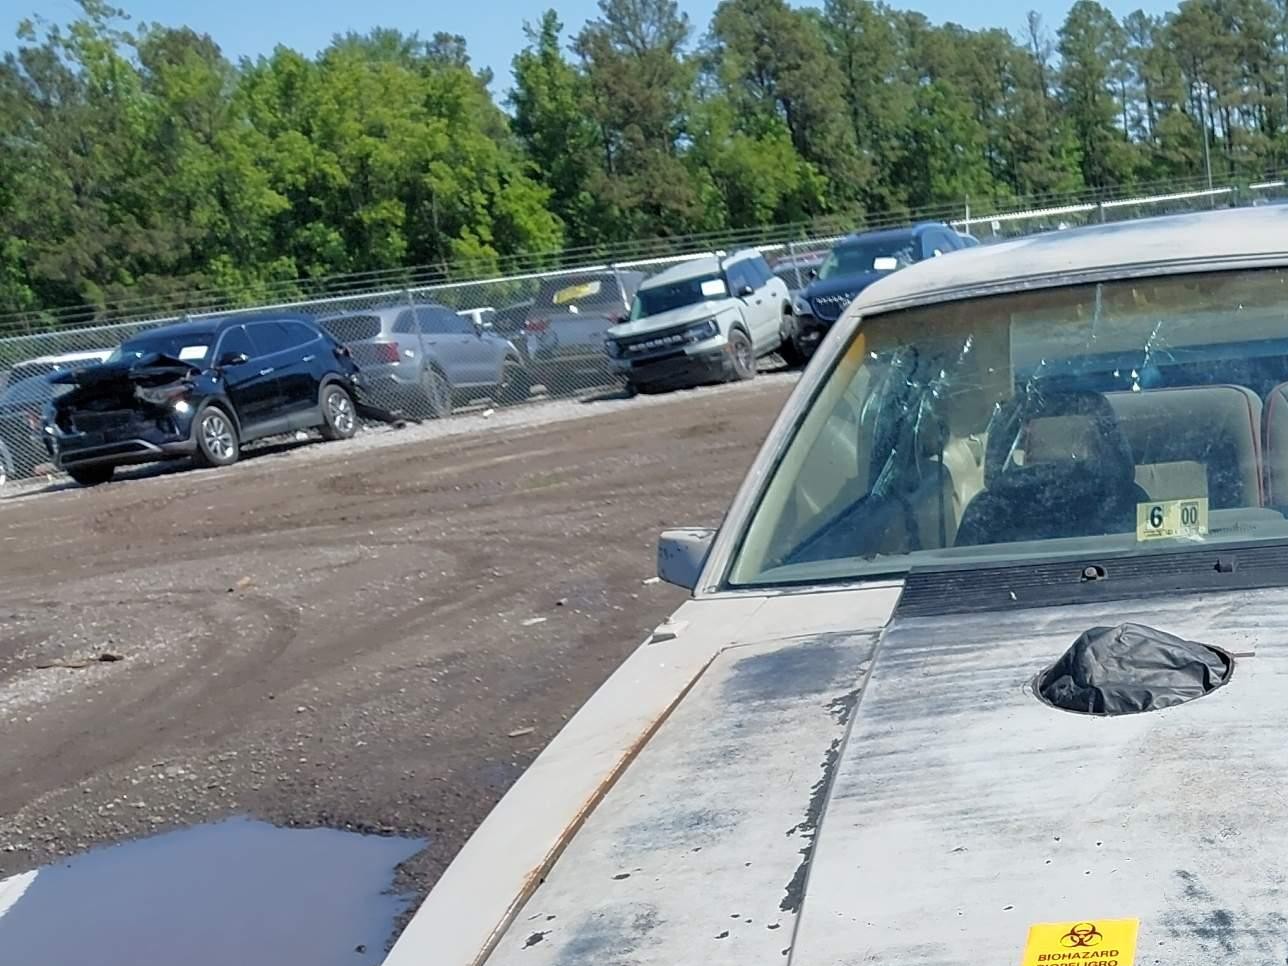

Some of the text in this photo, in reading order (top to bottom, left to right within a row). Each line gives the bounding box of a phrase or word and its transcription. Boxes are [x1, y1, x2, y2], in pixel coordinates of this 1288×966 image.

[1150, 506, 1198, 528] 6 00
[1037, 949, 1120, 962] BIOHAZARD
